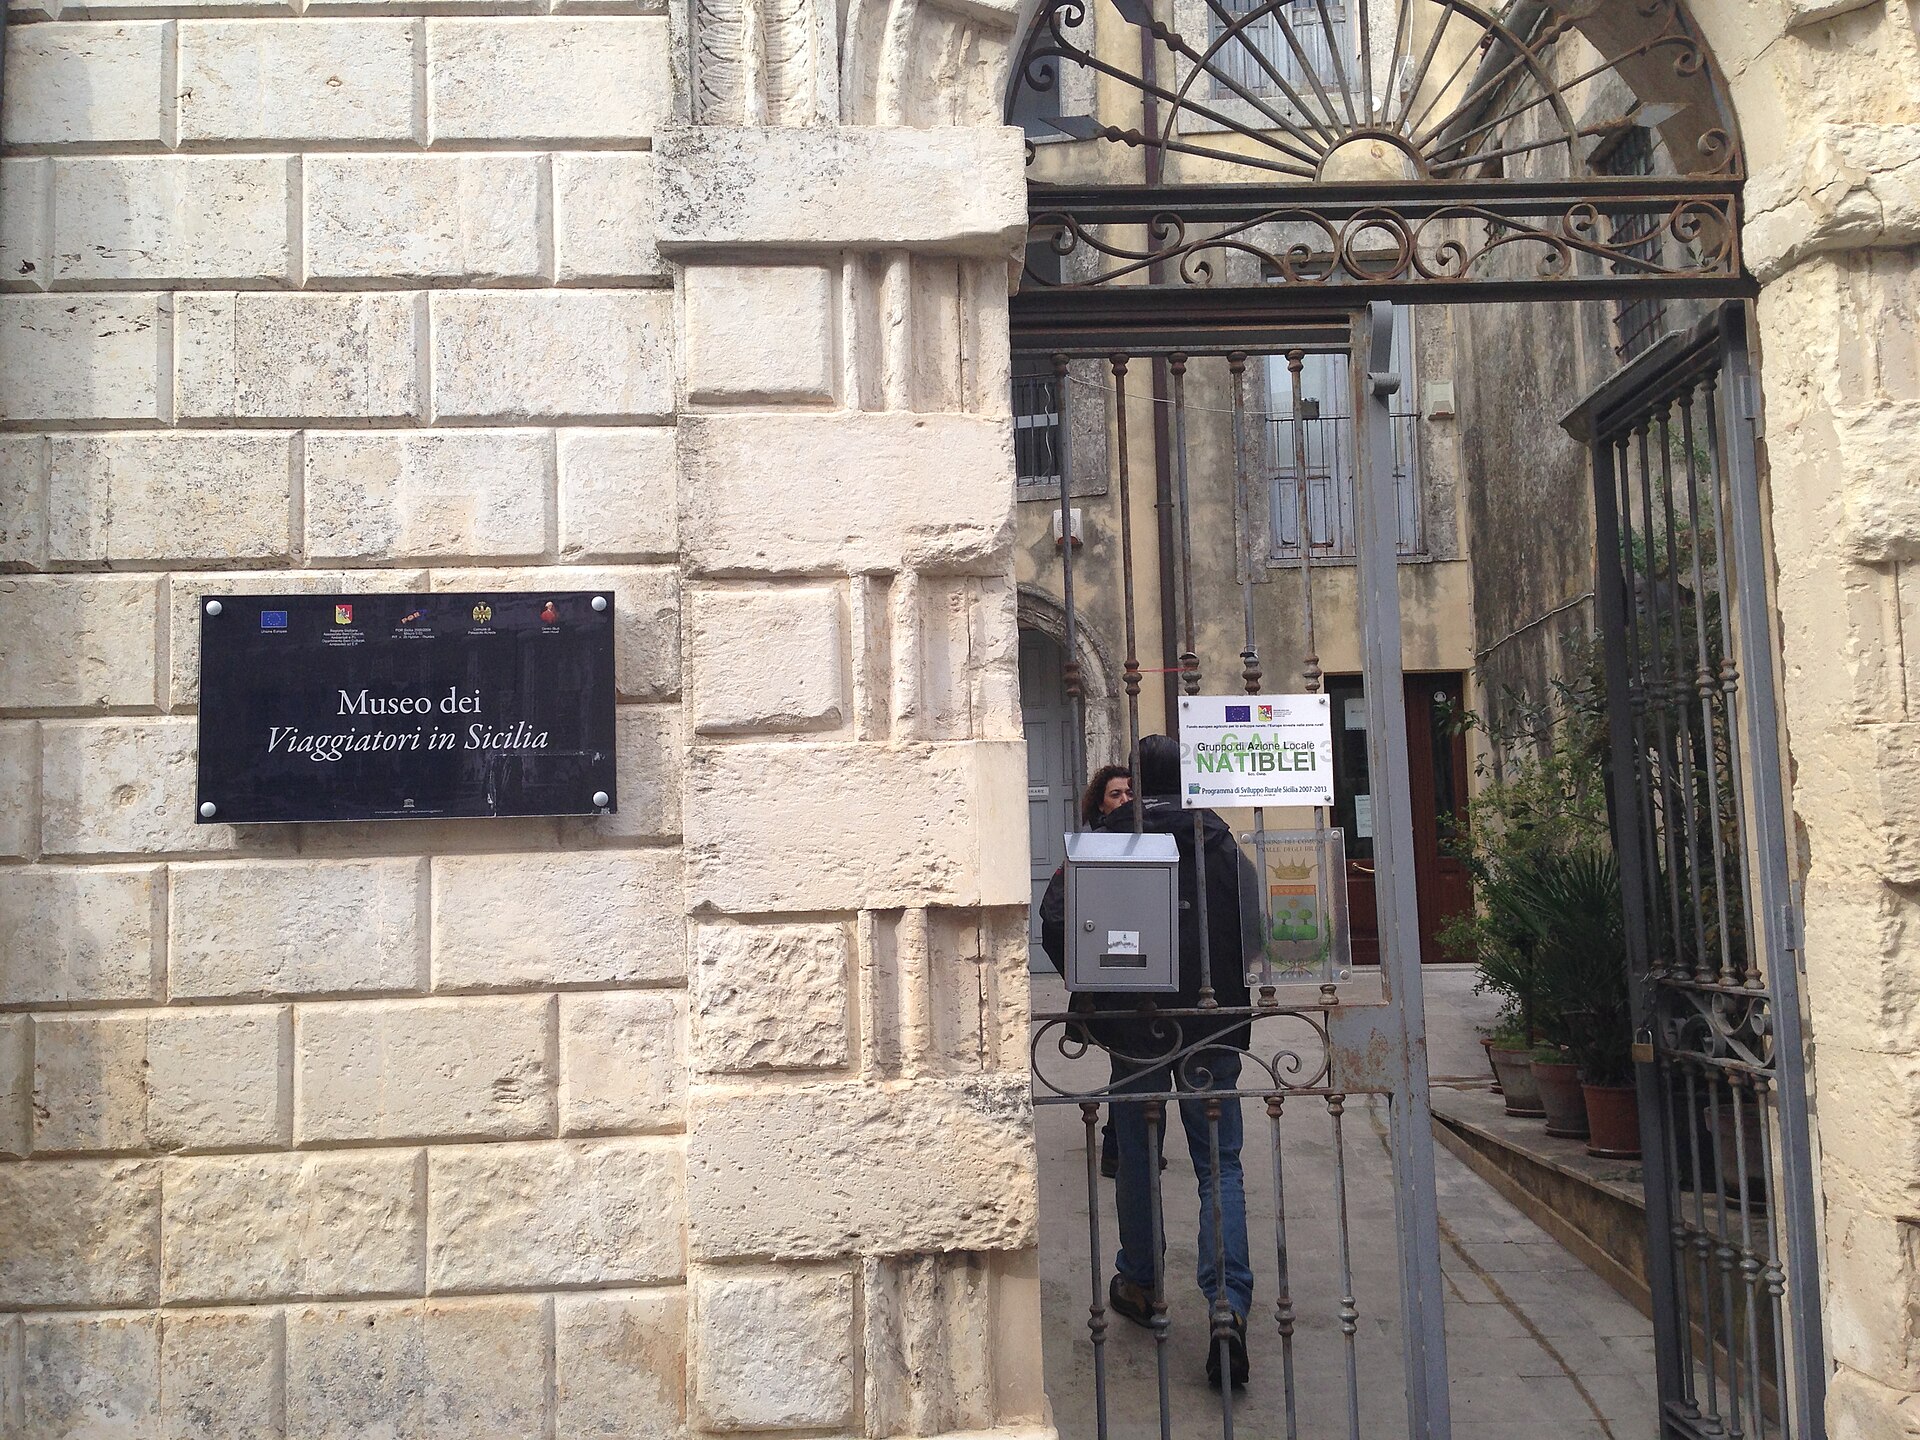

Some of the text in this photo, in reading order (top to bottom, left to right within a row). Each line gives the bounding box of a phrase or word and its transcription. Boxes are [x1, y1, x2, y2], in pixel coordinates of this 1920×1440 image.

[337, 686, 482, 715] Museo dei
[268, 721, 549, 762] Viaggiatori in Sicilia
[1198, 741, 1315, 752] Gruppo di Azione Locale
[1197, 752, 1316, 773] NATIBLEI
[1202, 787, 1234, 796] Programma
[1235, 786, 1240, 794] di
[1241, 786, 1264, 795] Sviluppo
[1264, 786, 1282, 794] Rurale
[1282, 785, 1299, 793] Sicilia
[1299, 785, 1327, 793] 2007-2013
